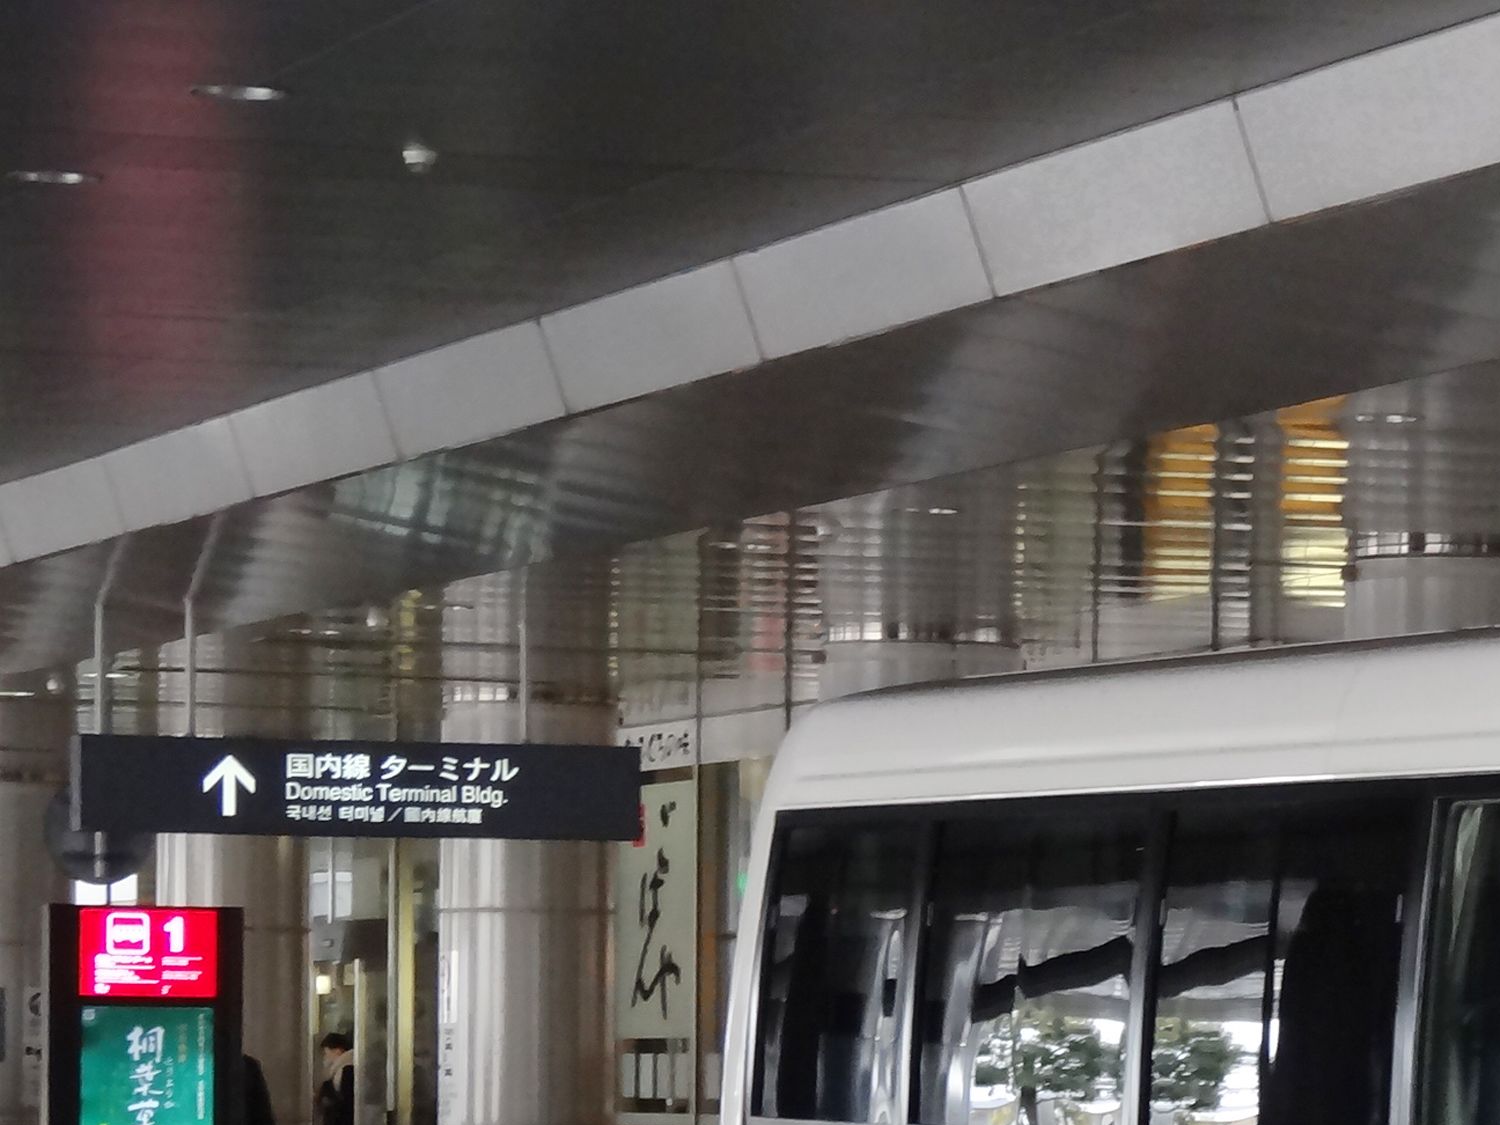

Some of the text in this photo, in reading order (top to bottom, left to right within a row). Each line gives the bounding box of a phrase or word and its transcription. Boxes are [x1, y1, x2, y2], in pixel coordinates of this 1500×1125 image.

[285, 753, 520, 782] 国内線 ターミナル
[285, 781, 509, 808] Domestic Terminal Bldg.
[162, 915, 184, 953] 1
